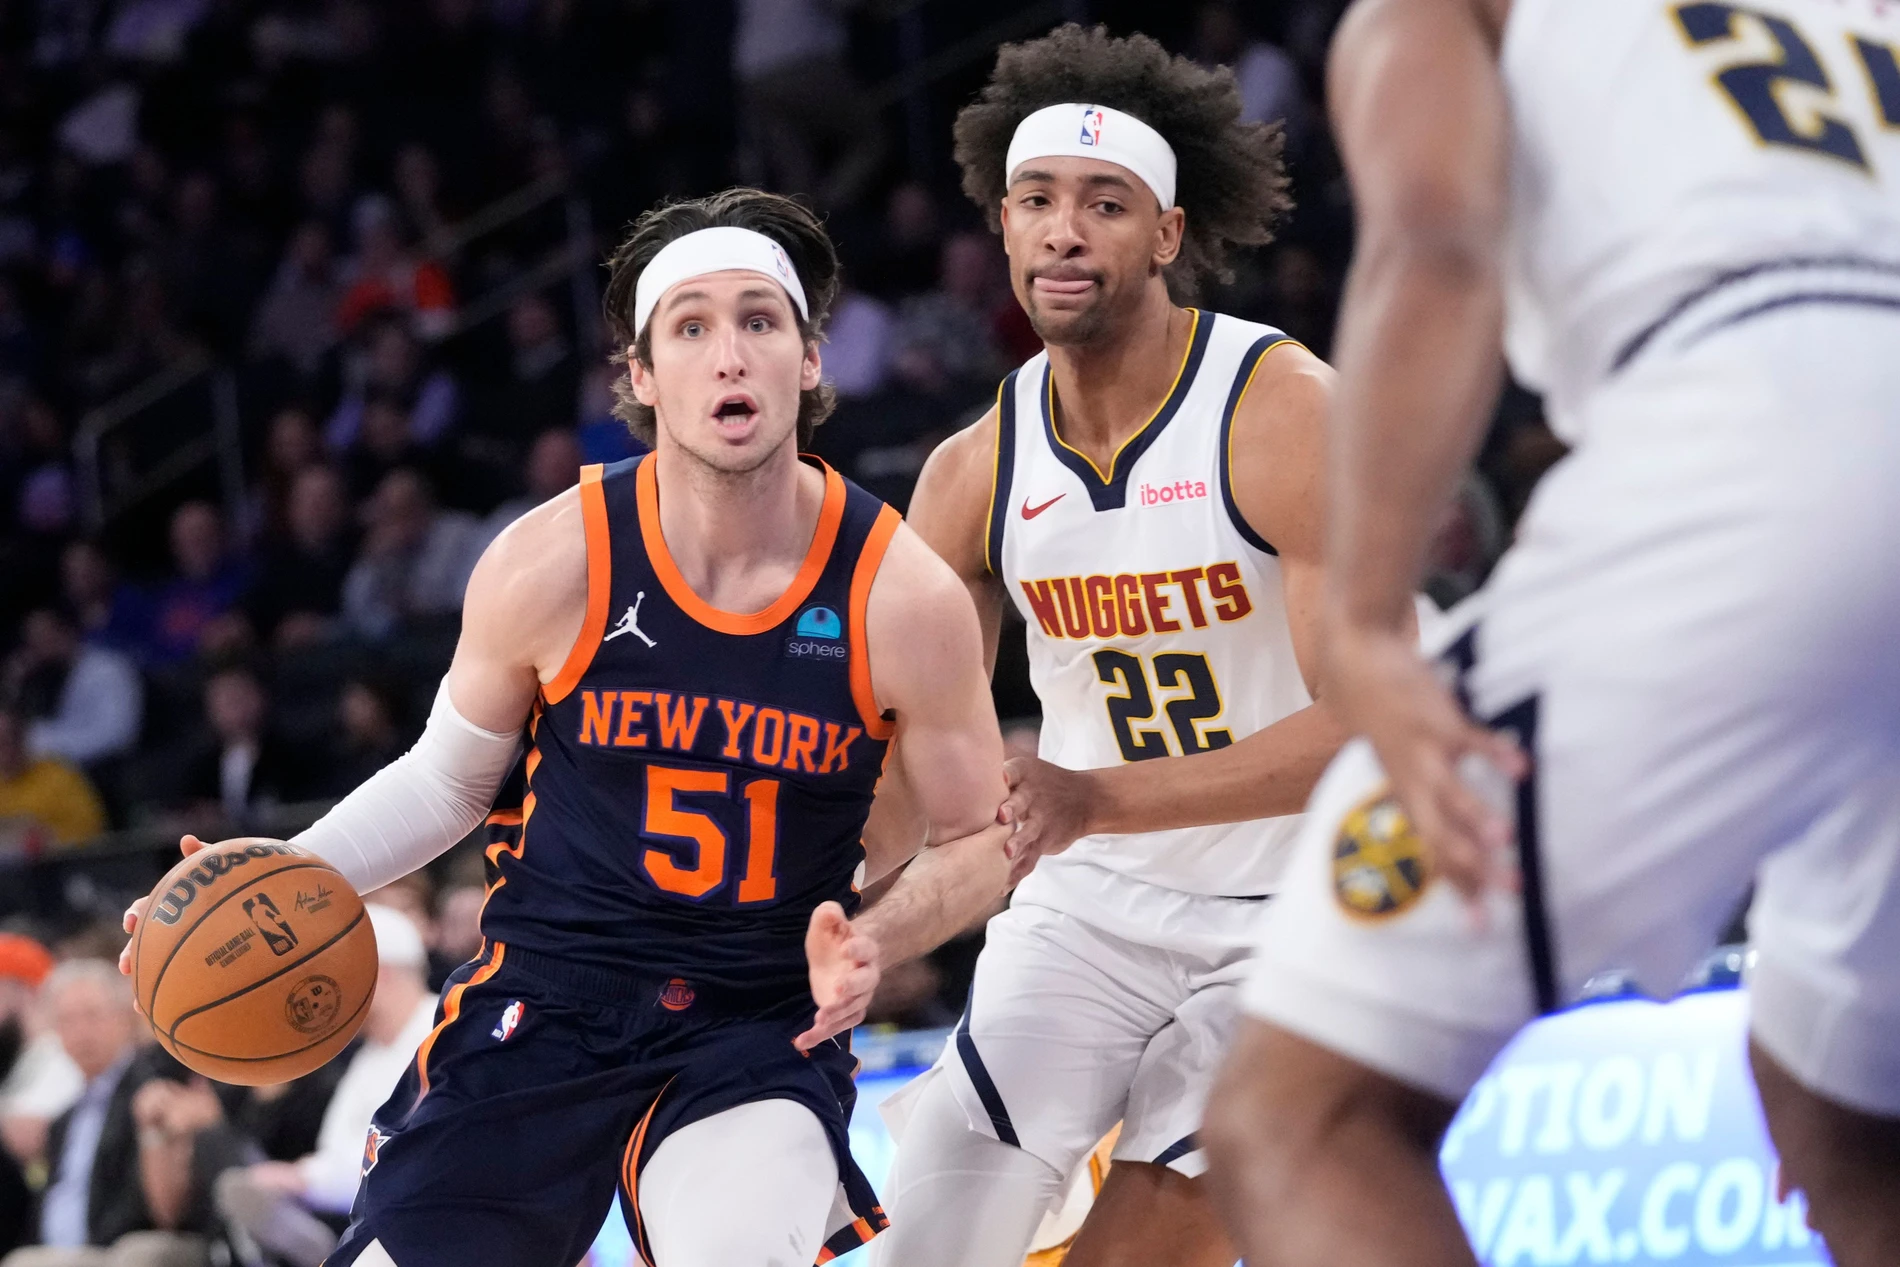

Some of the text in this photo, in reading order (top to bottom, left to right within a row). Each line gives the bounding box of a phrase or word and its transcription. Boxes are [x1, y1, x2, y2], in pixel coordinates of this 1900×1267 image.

[1140, 480, 1207, 506] ibotta
[1019, 560, 1254, 640] NUGGETS
[788, 640, 846, 659] sphere
[578, 690, 863, 774] NEW YORK
[1091, 646, 1236, 764] 22
[640, 764, 782, 905] 51
[152, 842, 307, 927] Wilson
[205, 927, 256, 966] OFFICIAL GAME BALL
